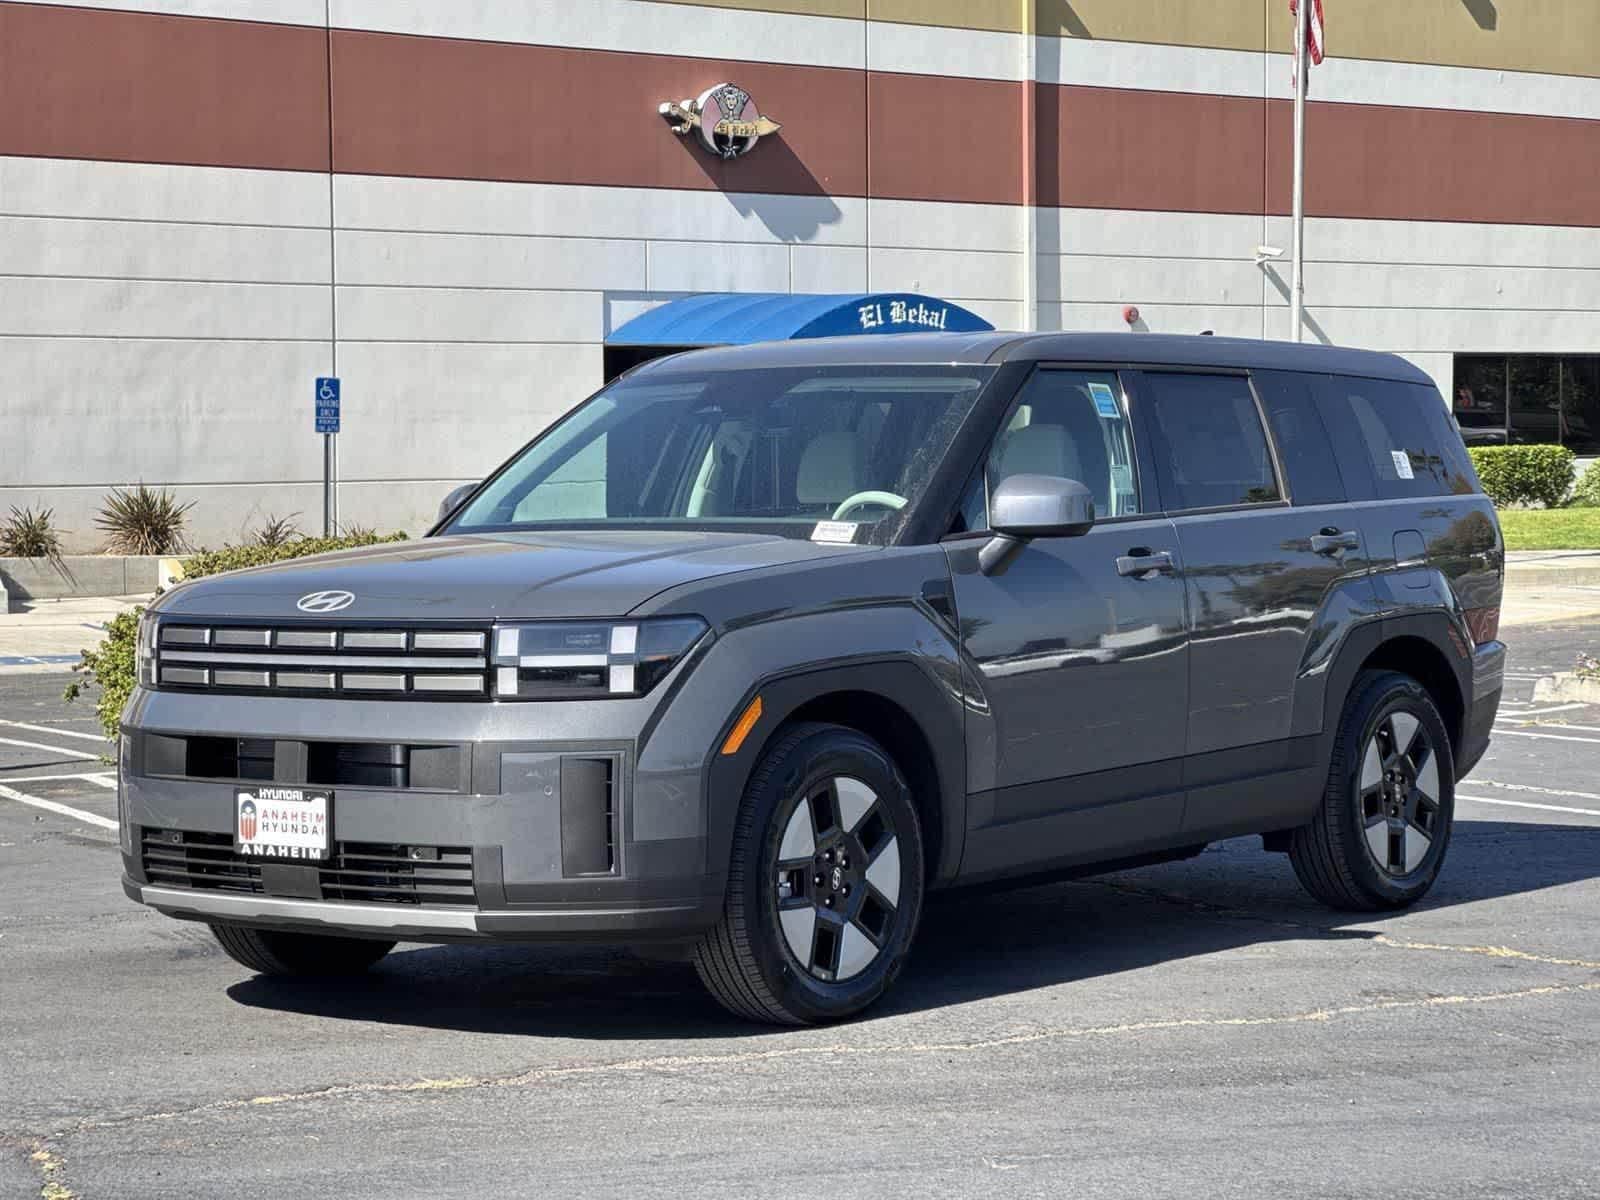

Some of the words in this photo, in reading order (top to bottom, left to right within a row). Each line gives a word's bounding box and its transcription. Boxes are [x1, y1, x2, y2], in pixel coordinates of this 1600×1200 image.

[858, 304, 884, 329] El
[890, 300, 948, 329] Bekal
[259, 788, 304, 801] HYUNDAI
[262, 809, 325, 823] ANAHEIM
[262, 822, 325, 836] HYUNDAI
[241, 843, 321, 860] ANAHEIM
